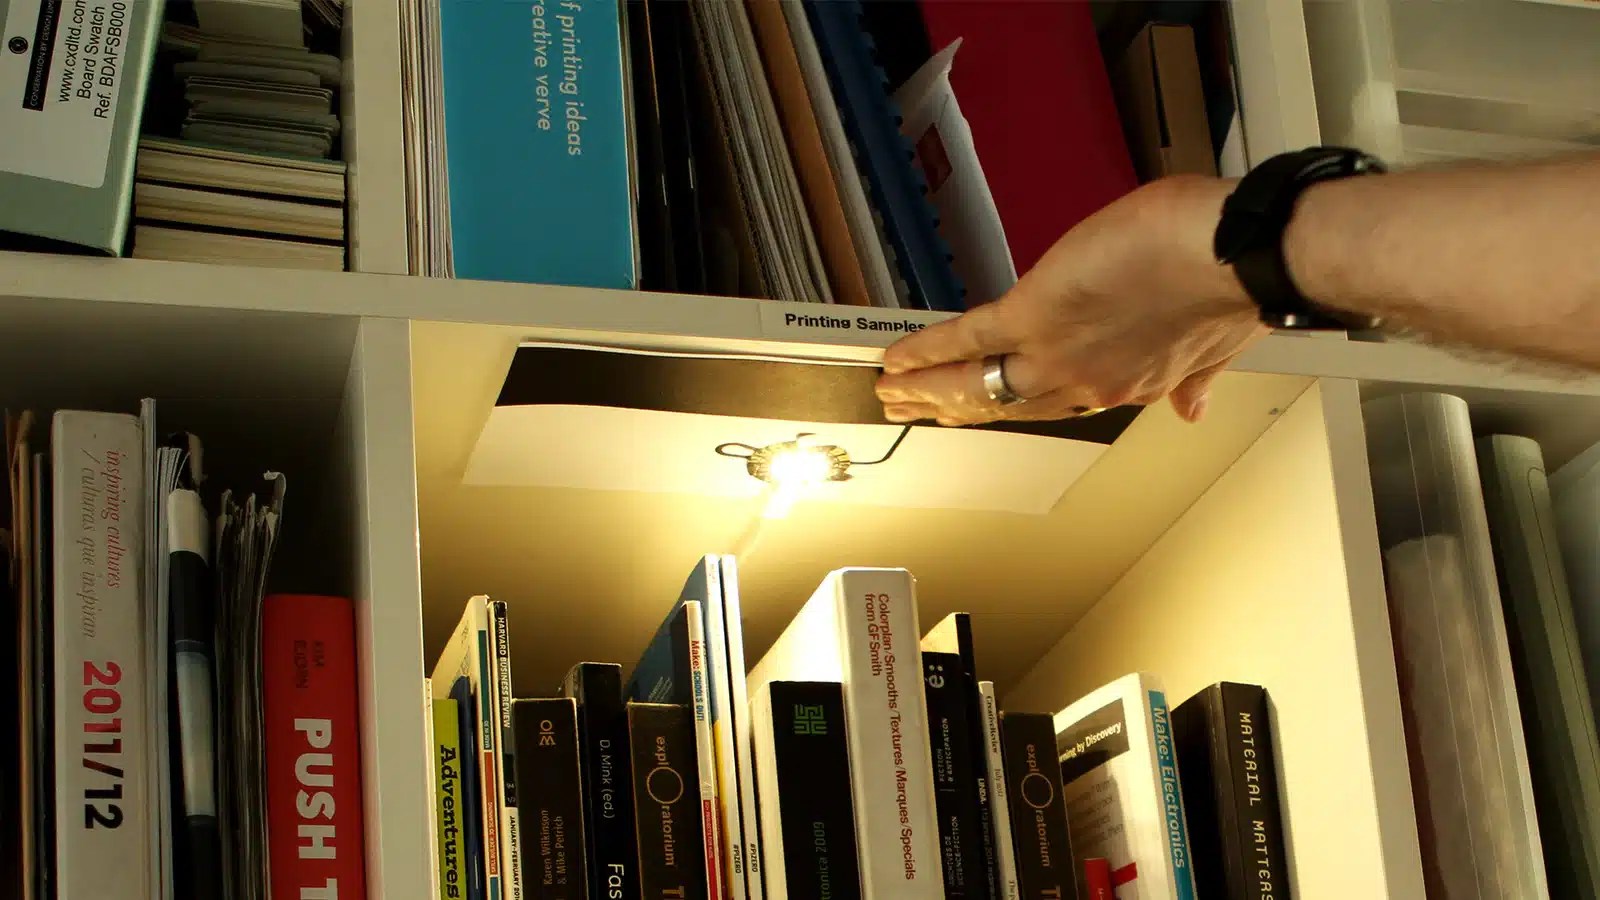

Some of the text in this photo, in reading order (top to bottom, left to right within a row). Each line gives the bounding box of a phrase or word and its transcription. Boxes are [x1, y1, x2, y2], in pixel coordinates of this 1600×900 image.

[77, 7, 104, 99] Board Swatch
[94, 2, 126, 118] Ref. BDAFSB000
[556, 0, 587, 155] f printing ideas
[536, 75, 551, 130] verve
[785, 313, 926, 332] Printing Samples
[81, 468, 100, 531] culturas
[102, 450, 128, 589] inspiring cultures
[76, 537, 97, 565] que
[77, 572, 102, 639] inspiran
[865, 594, 882, 676] from GF Smith
[498, 617, 510, 728] HARVARD BUSINESS REVIEW
[692, 641, 700, 669] Make:
[83, 661, 124, 829] 2011/12
[1077, 742, 1085, 752] by
[1085, 722, 1121, 747] Discovery
[294, 718, 336, 860] PUSH
[599, 740, 615, 819] D. Mink (ed.)
[1153, 707, 1185, 868] Make: Electronics
[1239, 712, 1274, 900] MATERIAL MATTERS
[441, 745, 461, 898] Adventures
[541, 810, 552, 885] Karen Wilkinson
[554, 816, 564, 848] Petrich
[813, 821, 827, 852] 2009
[557, 852, 566, 873] Mike
